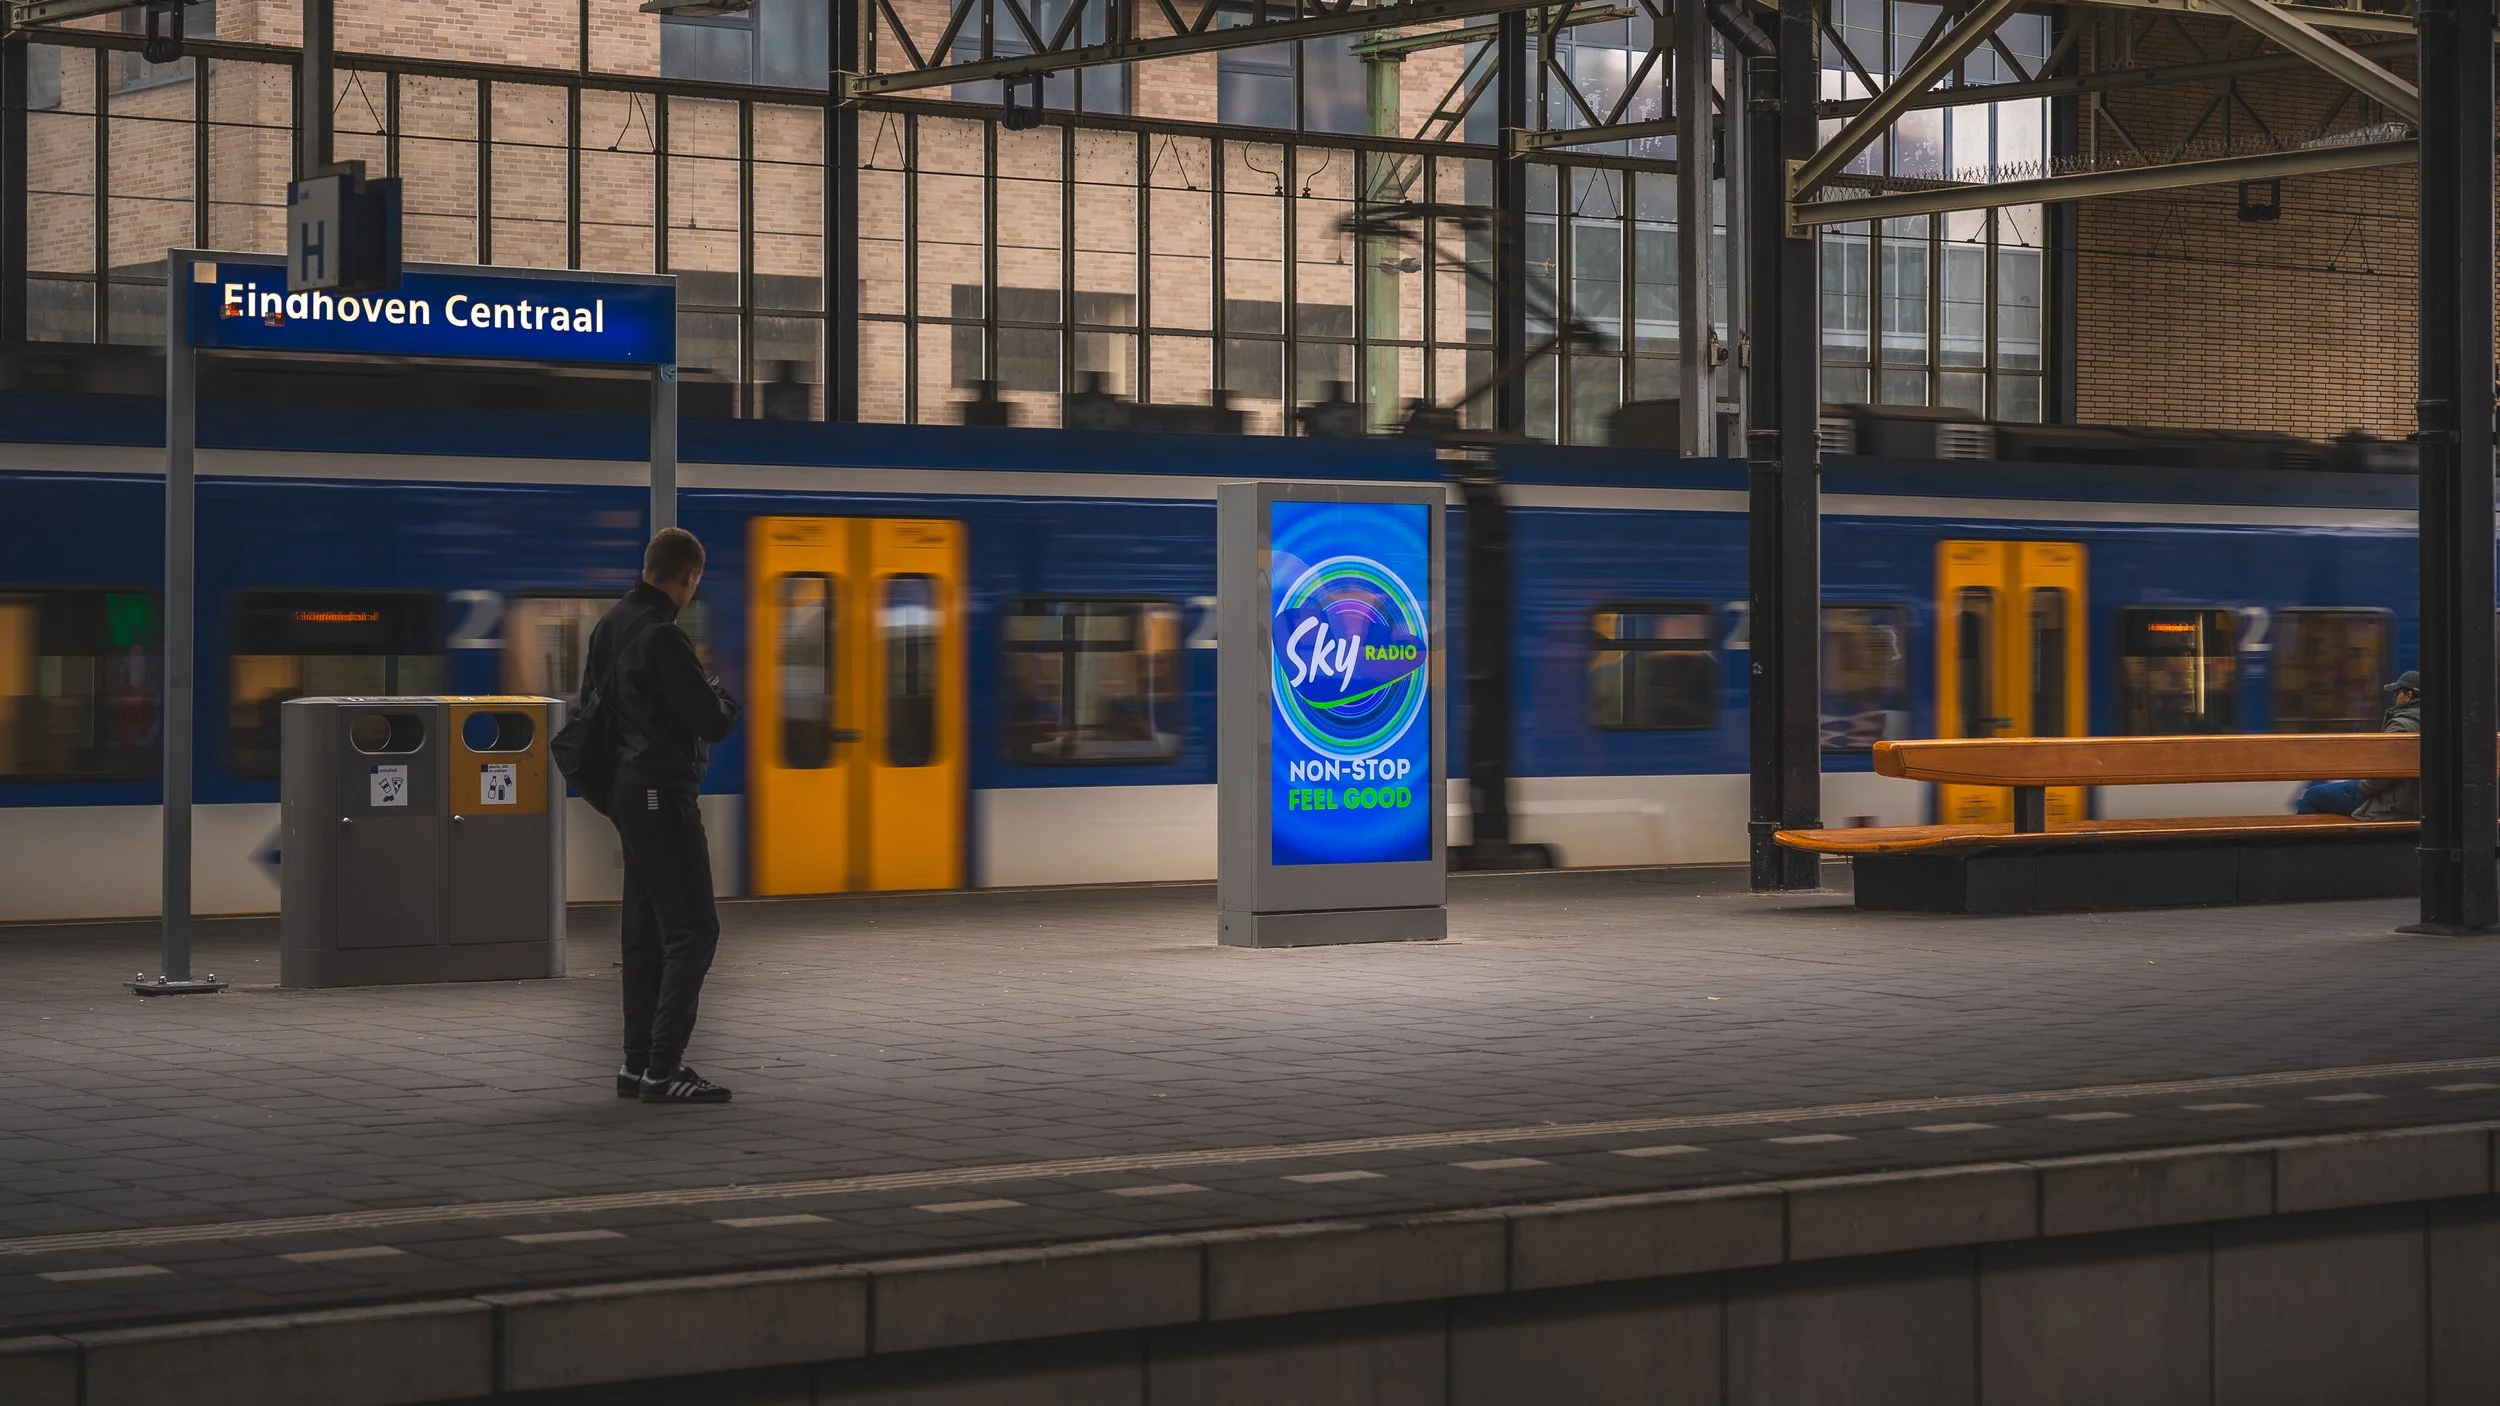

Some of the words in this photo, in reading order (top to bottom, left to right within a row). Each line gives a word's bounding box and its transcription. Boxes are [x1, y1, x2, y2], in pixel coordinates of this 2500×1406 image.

[302, 221, 325, 282] H
[224, 282, 430, 325] Eindhoven
[445, 295, 604, 333] Centraal
[446, 590, 508, 649] 2
[2240, 606, 2273, 652] 2
[1286, 616, 1361, 693] Sky
[1365, 644, 1418, 661] RADIO
[1289, 758, 1411, 782] NON-STOP
[1288, 788, 1339, 811] FEEL
[1343, 786, 1412, 809] GOOD
